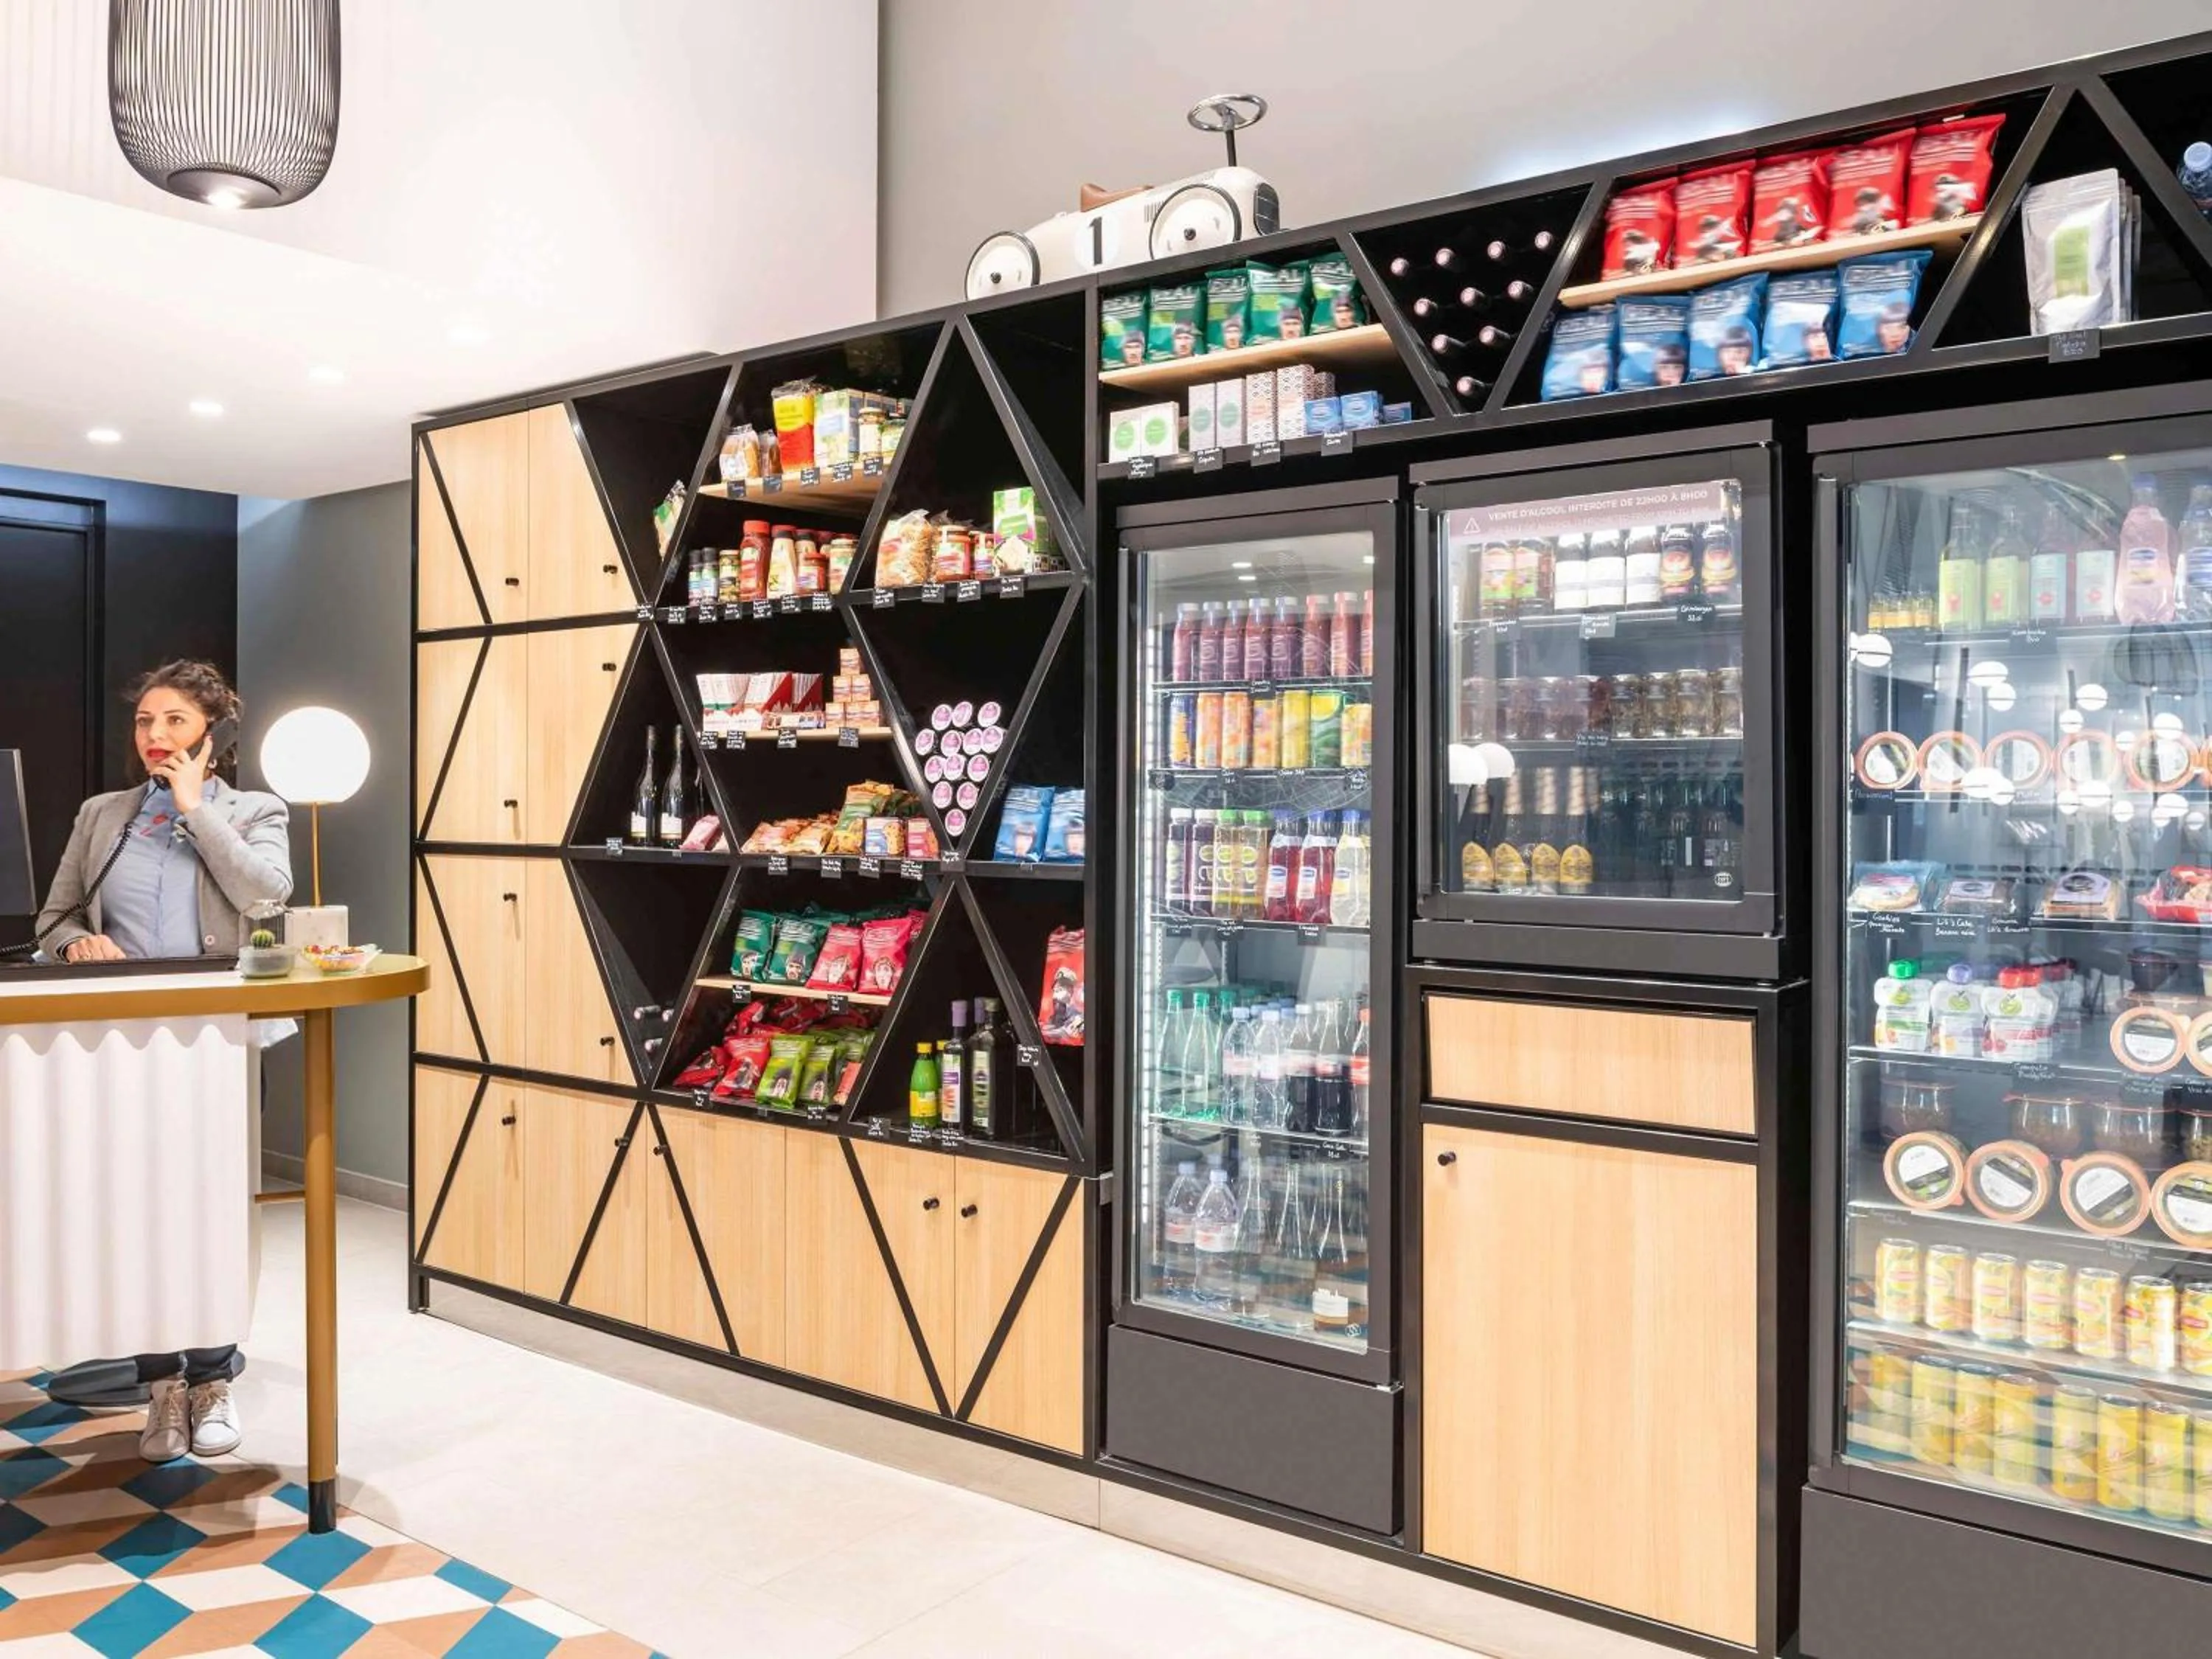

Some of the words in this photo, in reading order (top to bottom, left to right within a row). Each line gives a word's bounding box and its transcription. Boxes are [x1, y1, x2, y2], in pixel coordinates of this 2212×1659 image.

[1088, 216, 1102, 265] 1
[1489, 509, 1517, 521] VENTE
[1520, 505, 1565, 518] D'ALCOOL
[1568, 499, 1617, 512] INTERDITE
[1620, 498, 1633, 507] DE
